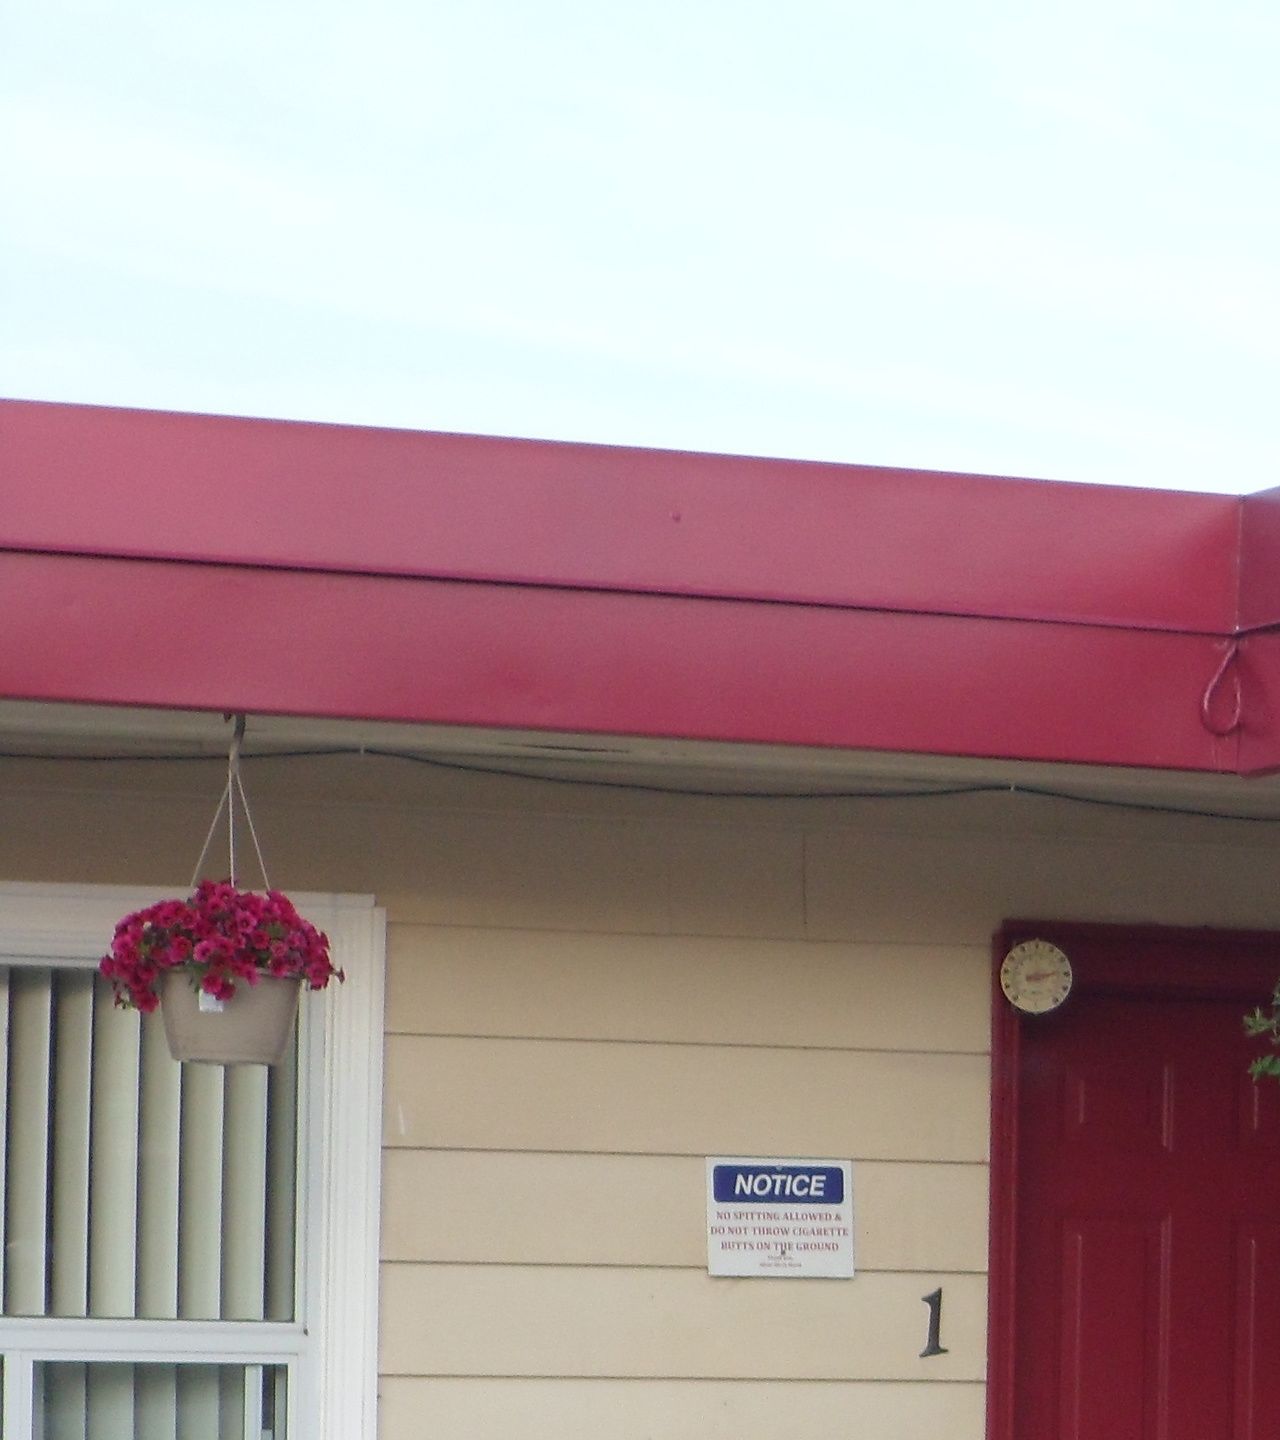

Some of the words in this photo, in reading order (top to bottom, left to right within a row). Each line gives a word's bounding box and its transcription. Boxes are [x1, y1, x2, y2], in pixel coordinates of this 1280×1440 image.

[734, 1173, 827, 1197] NOTICE
[716, 1211, 731, 1221] NO
[734, 1211, 780, 1221] SPITTING
[783, 1212, 832, 1221] ALLOWED
[710, 1226, 725, 1235] DO
[728, 1226, 748, 1236] NOT
[751, 1226, 790, 1236] THROW
[792, 1226, 849, 1237] CIGARETTE
[721, 1241, 754, 1250] BUTTS
[756, 1241, 770, 1250] ON
[773, 1241, 792, 1251] THE
[796, 1242, 839, 1251] GROUND
[918, 1286, 949, 1358] 1
